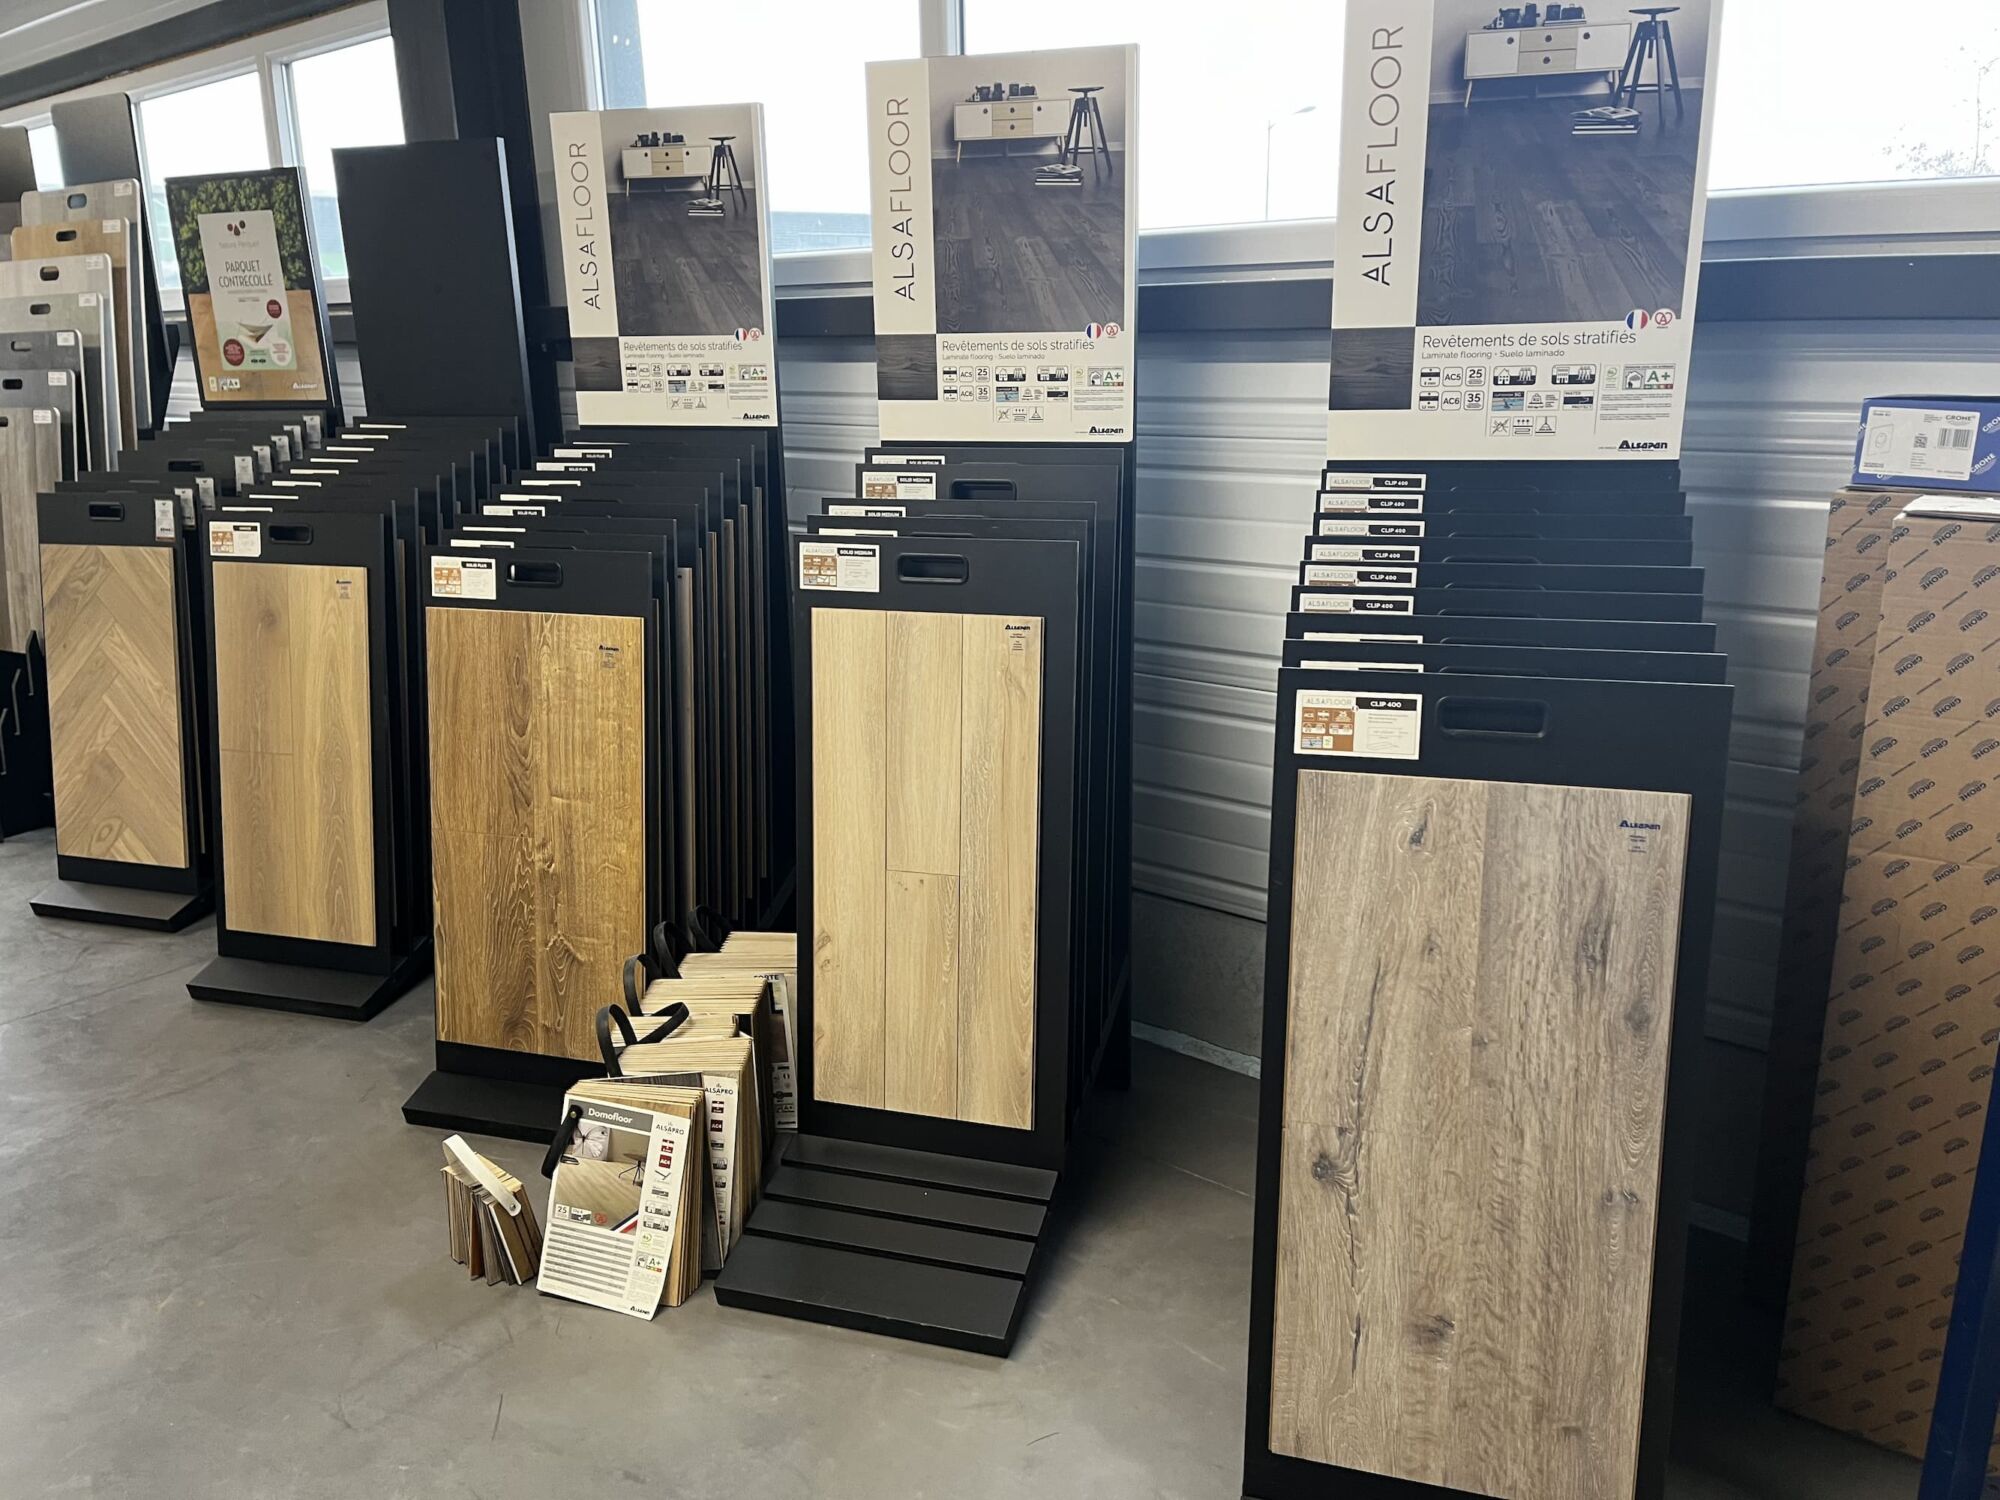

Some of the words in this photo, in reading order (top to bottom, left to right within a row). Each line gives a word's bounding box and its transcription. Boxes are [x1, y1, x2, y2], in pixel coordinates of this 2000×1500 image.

[1362, 25, 1404, 287] ALSAFLOOR
[886, 97, 918, 302] ALSAFLOOR
[569, 142, 600, 310] ALSAFLOOR
[225, 260, 260, 274] PARQUET
[624, 342, 675, 351] Revêtements
[678, 342, 688, 350] de
[690, 342, 706, 350] sols
[708, 342, 742, 350] stratifiés
[942, 340, 1008, 352] Revêtements
[1010, 340, 1025, 351] de
[1027, 340, 1048, 350] sols
[1050, 340, 1094, 350] stratifiés
[1422, 335, 1514, 348] Revêtements
[1518, 335, 1537, 346] de
[1541, 334, 1570, 346] sols
[1574, 330, 1636, 344] stratifiés
[970, 353, 994, 361] flooring
[1422, 351, 1459, 360] Laminate
[1460, 350, 1492, 360] flooring
[1500, 350, 1524, 358] Suelo
[1526, 350, 1565, 358] laminado
[1104, 372, 1121, 380] A+
[1469, 369, 1482, 378] 25
[1647, 370, 1670, 382] A+
[1467, 393, 1480, 402] 35
[1970, 453, 1996, 472] GROHE
[1868, 496, 1892, 516] GROHE
[1934, 524, 1962, 546] GROHE
[1857, 536, 1881, 554] GROHE
[1848, 574, 1870, 592] GROHE
[1921, 568, 1949, 590] GROHE
[1837, 612, 1860, 631] GROHE
[1908, 612, 1936, 633] GROHE
[1960, 611, 1988, 632] GROHE
[1896, 656, 1923, 676] GROHE
[1947, 655, 1974, 675] GROHE
[1883, 698, 1910, 717] GROHE
[1934, 698, 1961, 718] GROHE
[1871, 739, 1898, 758] GROHE
[1921, 740, 1948, 758] GROHE
[1973, 740, 2000, 760] GROHE
[1860, 779, 1885, 797] GROHE
[1909, 781, 1935, 799] GROHE
[1960, 782, 1986, 801] GROHE
[1896, 821, 1922, 839] GROHE
[1946, 824, 1973, 842] GROHE
[1935, 864, 1960, 882] GROHE
[1921, 904, 1947, 921] GROHE
[1971, 908, 1998, 925] GROHE
[1958, 948, 1985, 964] GROHE
[588, 1108, 633, 1124] Domofloor
[656, 1124, 685, 1135] ALSAPRO
[649, 1258, 660, 1266] A+
